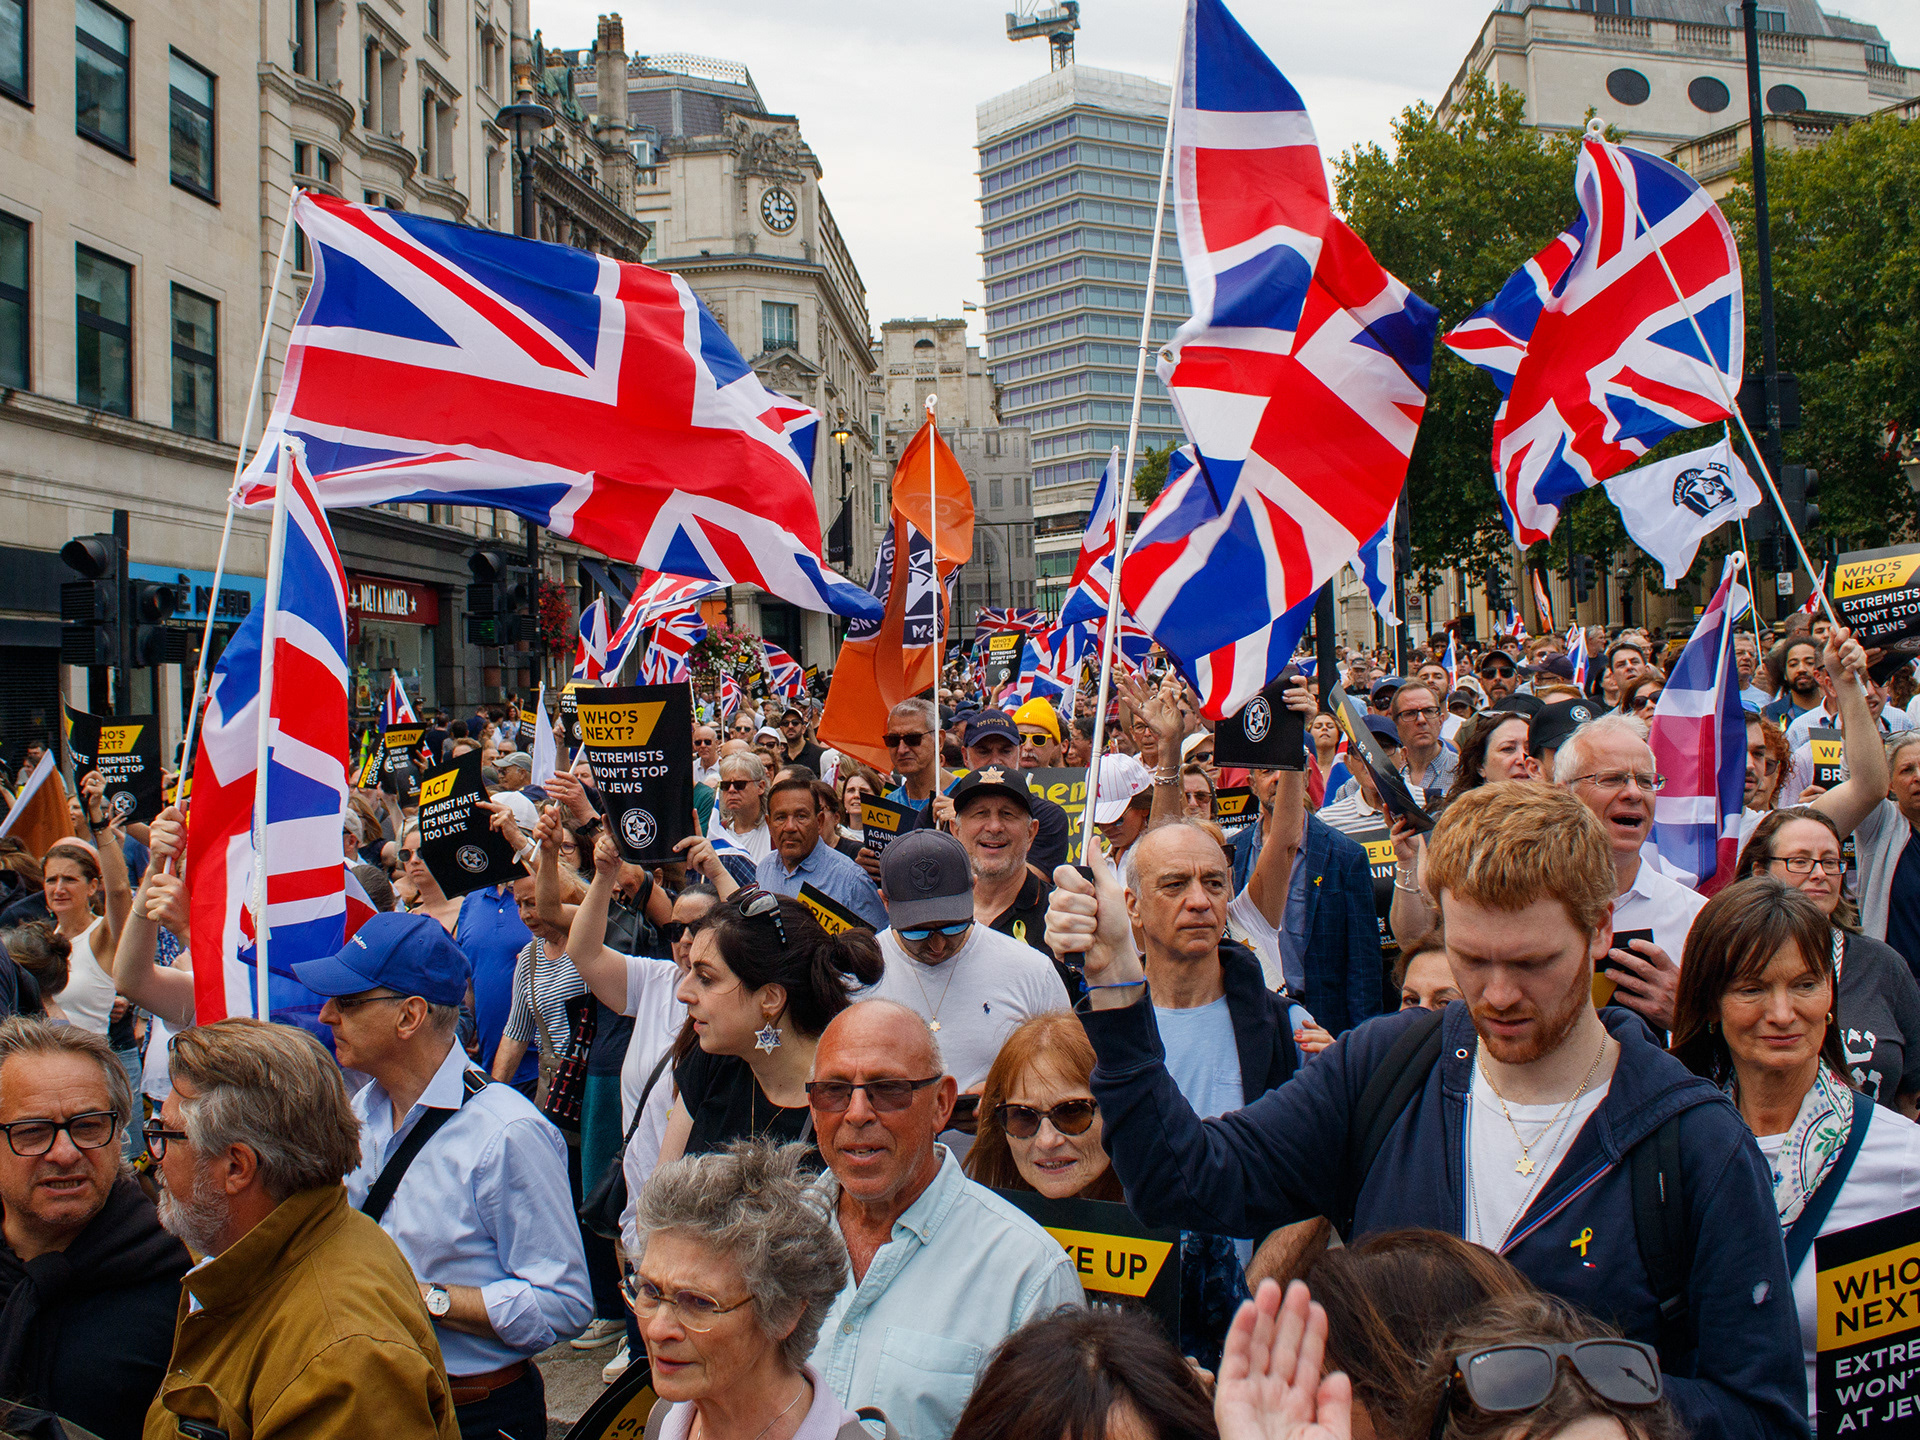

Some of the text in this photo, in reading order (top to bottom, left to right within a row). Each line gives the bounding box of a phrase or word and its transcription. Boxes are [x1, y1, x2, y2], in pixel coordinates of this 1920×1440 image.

[1844, 561, 1902, 578] WHO'S
[1842, 572, 1896, 592] NEXT?
[1842, 588, 1920, 612] EXTREMISTS
[1847, 609, 1889, 624] WON'T
[1871, 620, 1907, 635] JEWS
[523, 713, 535, 721] ACT
[583, 710, 639, 725] WHO'S
[101, 730, 126, 740] HO'S
[387, 733, 417, 744] BRITAIN
[586, 727, 635, 741] NEXT?
[98, 741, 124, 750] EXT?
[589, 750, 665, 763] EXTREMISTS
[99, 764, 145, 774] ON'T STOP
[593, 765, 669, 779] WON'T STOP
[425, 779, 448, 799] ACT
[609, 782, 643, 794] JEWS
[422, 791, 480, 817] AGAINST HATE
[422, 807, 471, 830] IT'S NEARLY
[867, 810, 892, 825] ACT
[1216, 815, 1247, 824] GAINST
[423, 822, 468, 841] TOO LATE
[868, 839, 883, 849] IT'S
[1382, 845, 1392, 857] U
[1106, 1250, 1148, 1280] UP
[1833, 1257, 1920, 1305] WHO
[1836, 1338, 1920, 1379] EXTRE
[1837, 1394, 1920, 1435] AT JE
